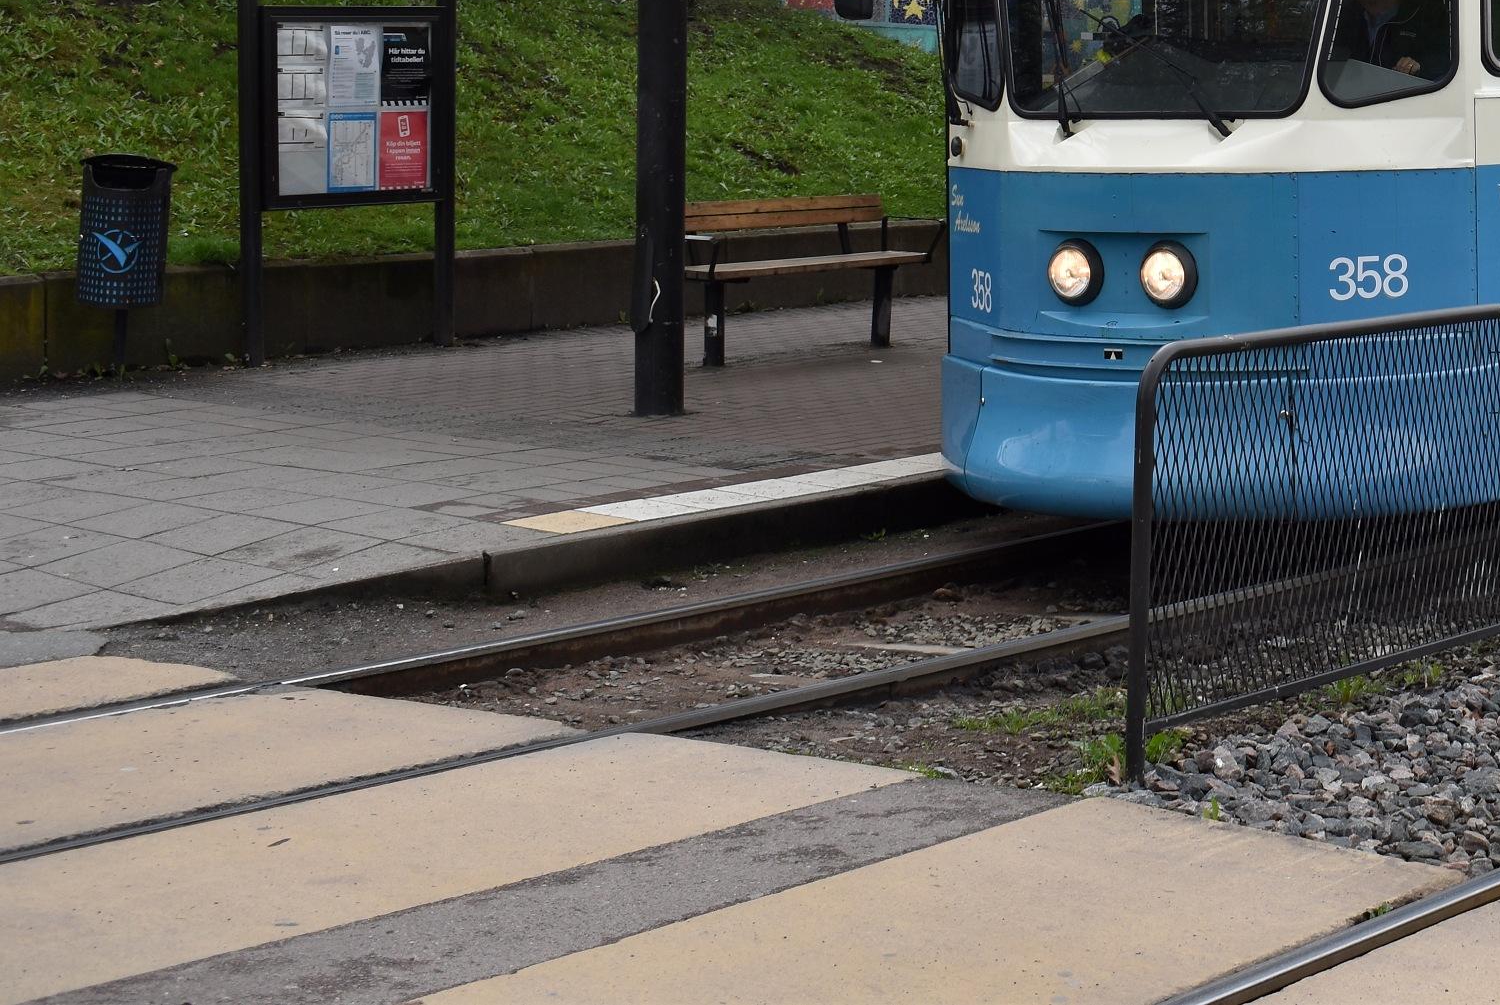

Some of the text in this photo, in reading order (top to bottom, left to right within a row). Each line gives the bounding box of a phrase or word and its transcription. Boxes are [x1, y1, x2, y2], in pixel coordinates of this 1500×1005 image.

[418, 47, 426, 55] du
[971, 268, 992, 313] 358
[1329, 253, 1409, 301] 358
